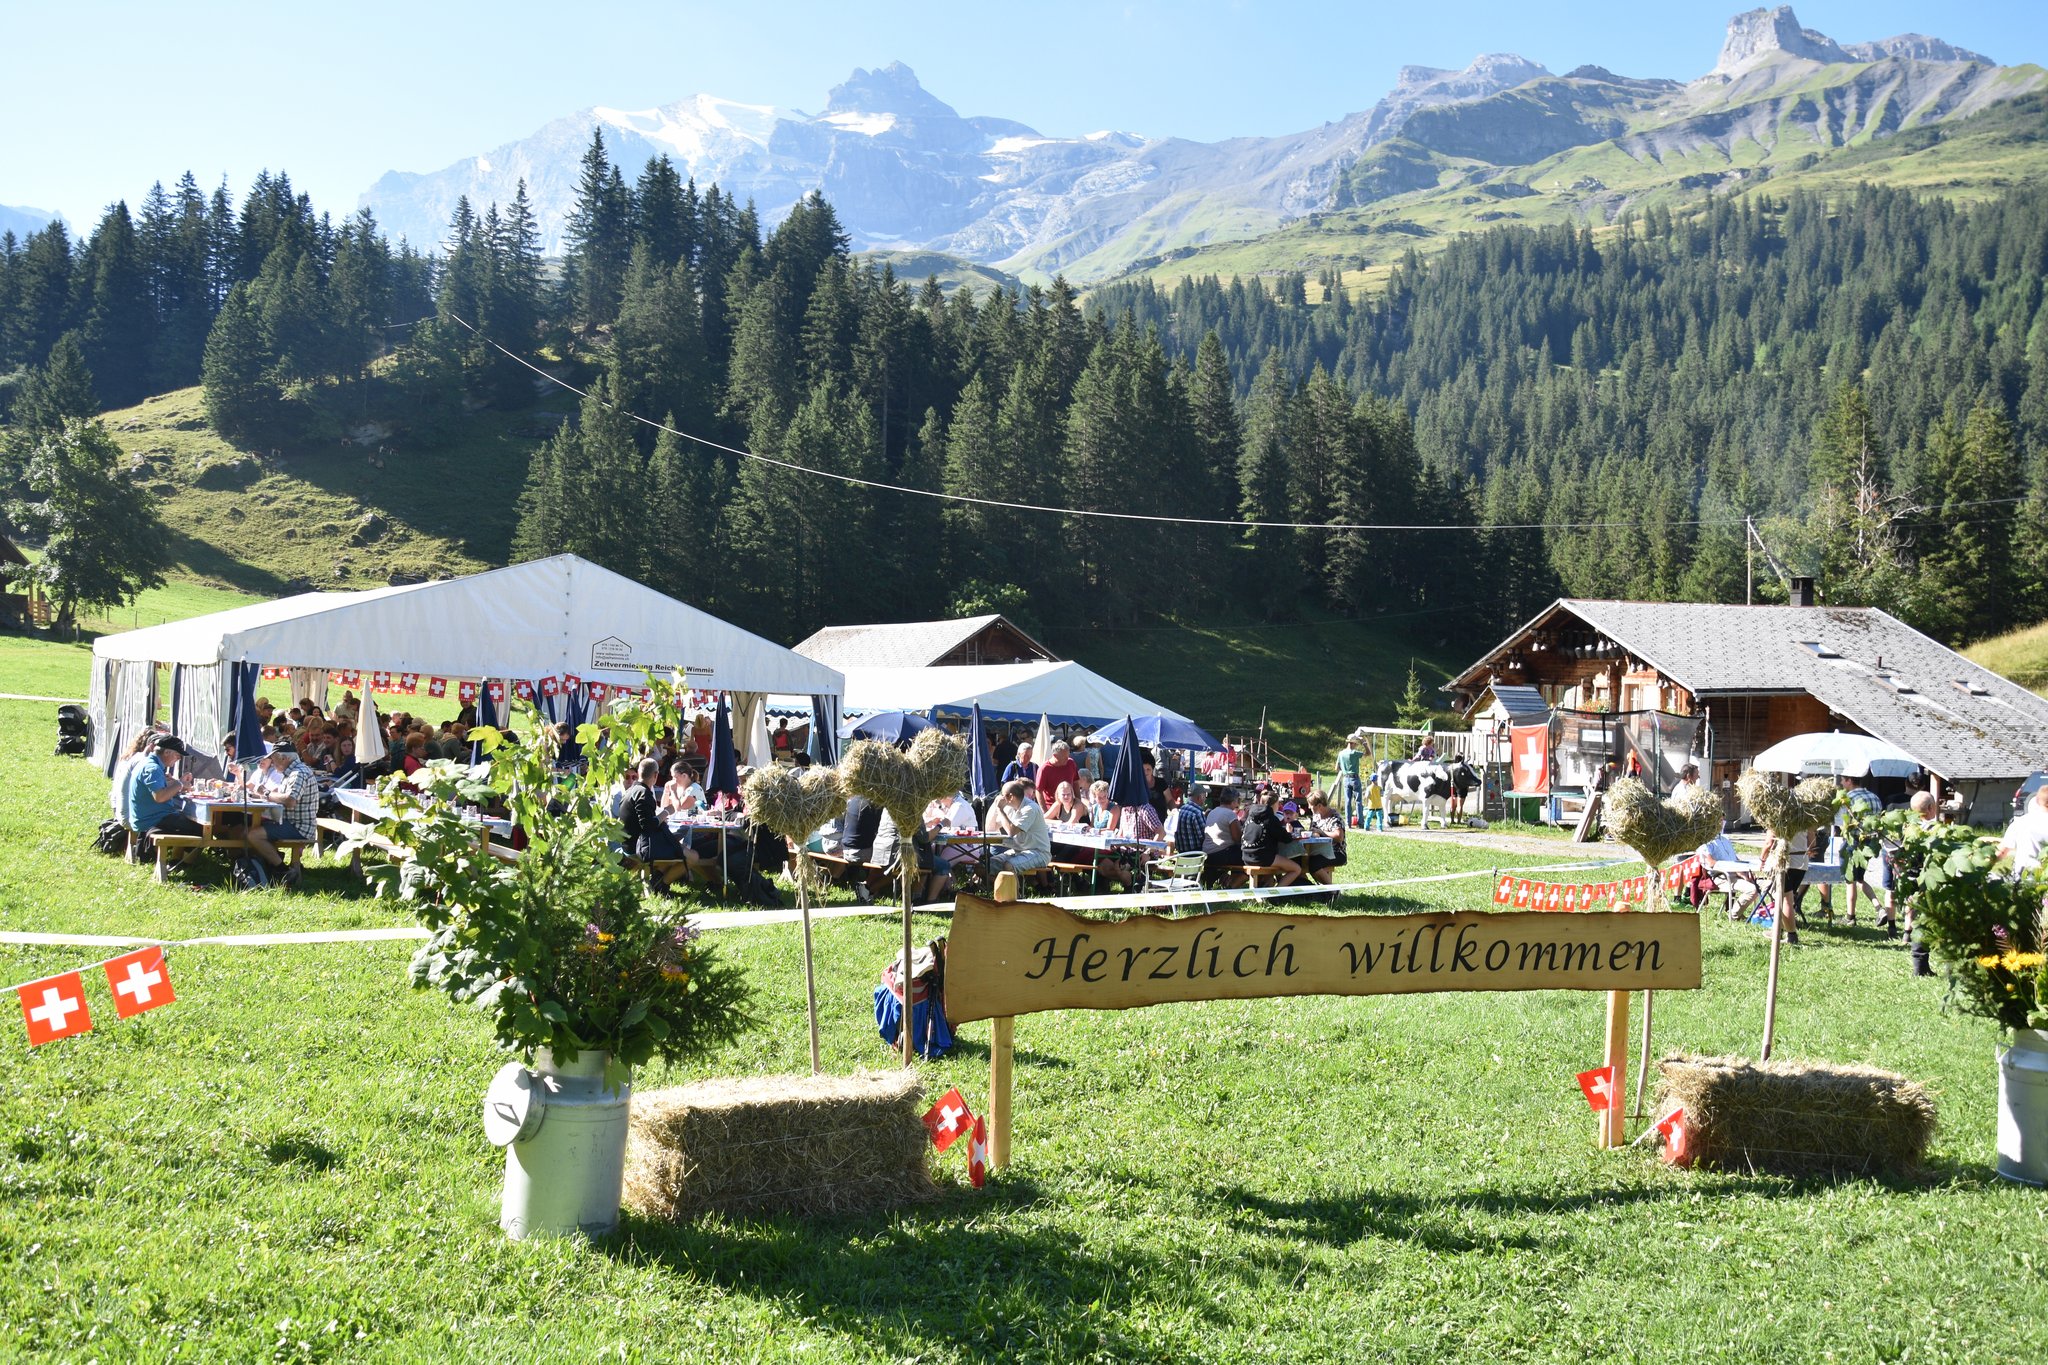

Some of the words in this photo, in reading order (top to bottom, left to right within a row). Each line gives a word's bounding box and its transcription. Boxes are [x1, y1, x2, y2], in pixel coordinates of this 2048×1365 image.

[655, 663, 683, 672] Reich
[686, 665, 715, 674] Wimmis
[1024, 924, 1301, 983] Herzlich
[1338, 921, 1665, 975] willkommen
